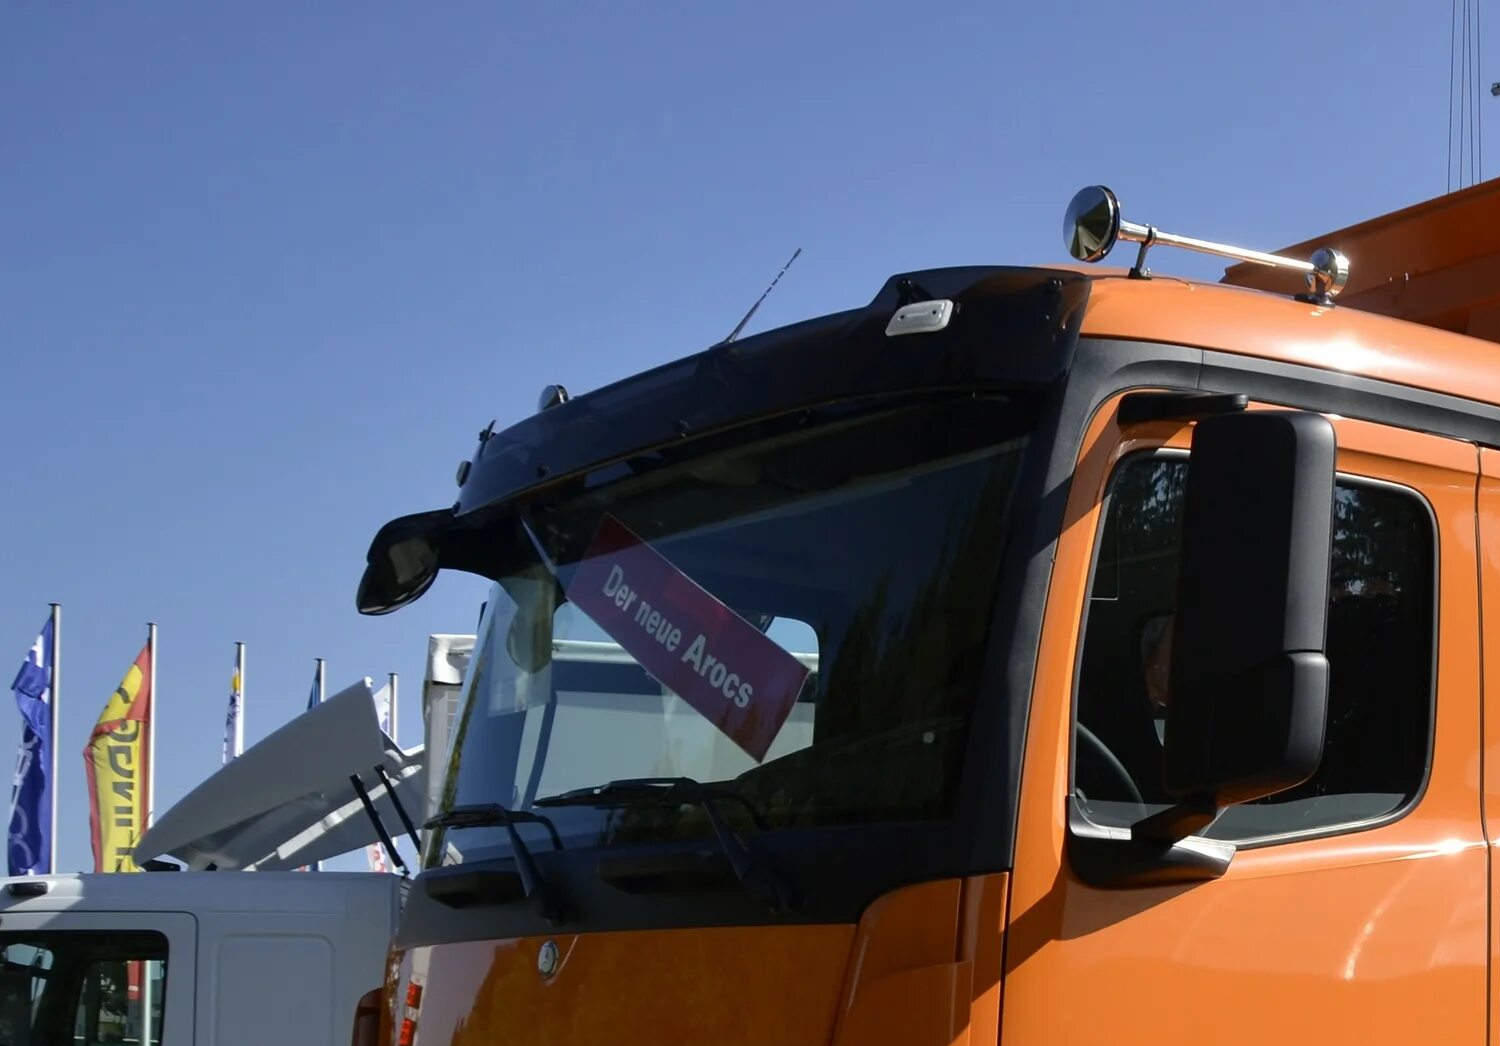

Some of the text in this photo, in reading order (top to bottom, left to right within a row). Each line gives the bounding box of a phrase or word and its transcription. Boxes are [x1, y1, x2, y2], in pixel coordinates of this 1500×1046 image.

[602, 563, 754, 709] Der neue Arocs
